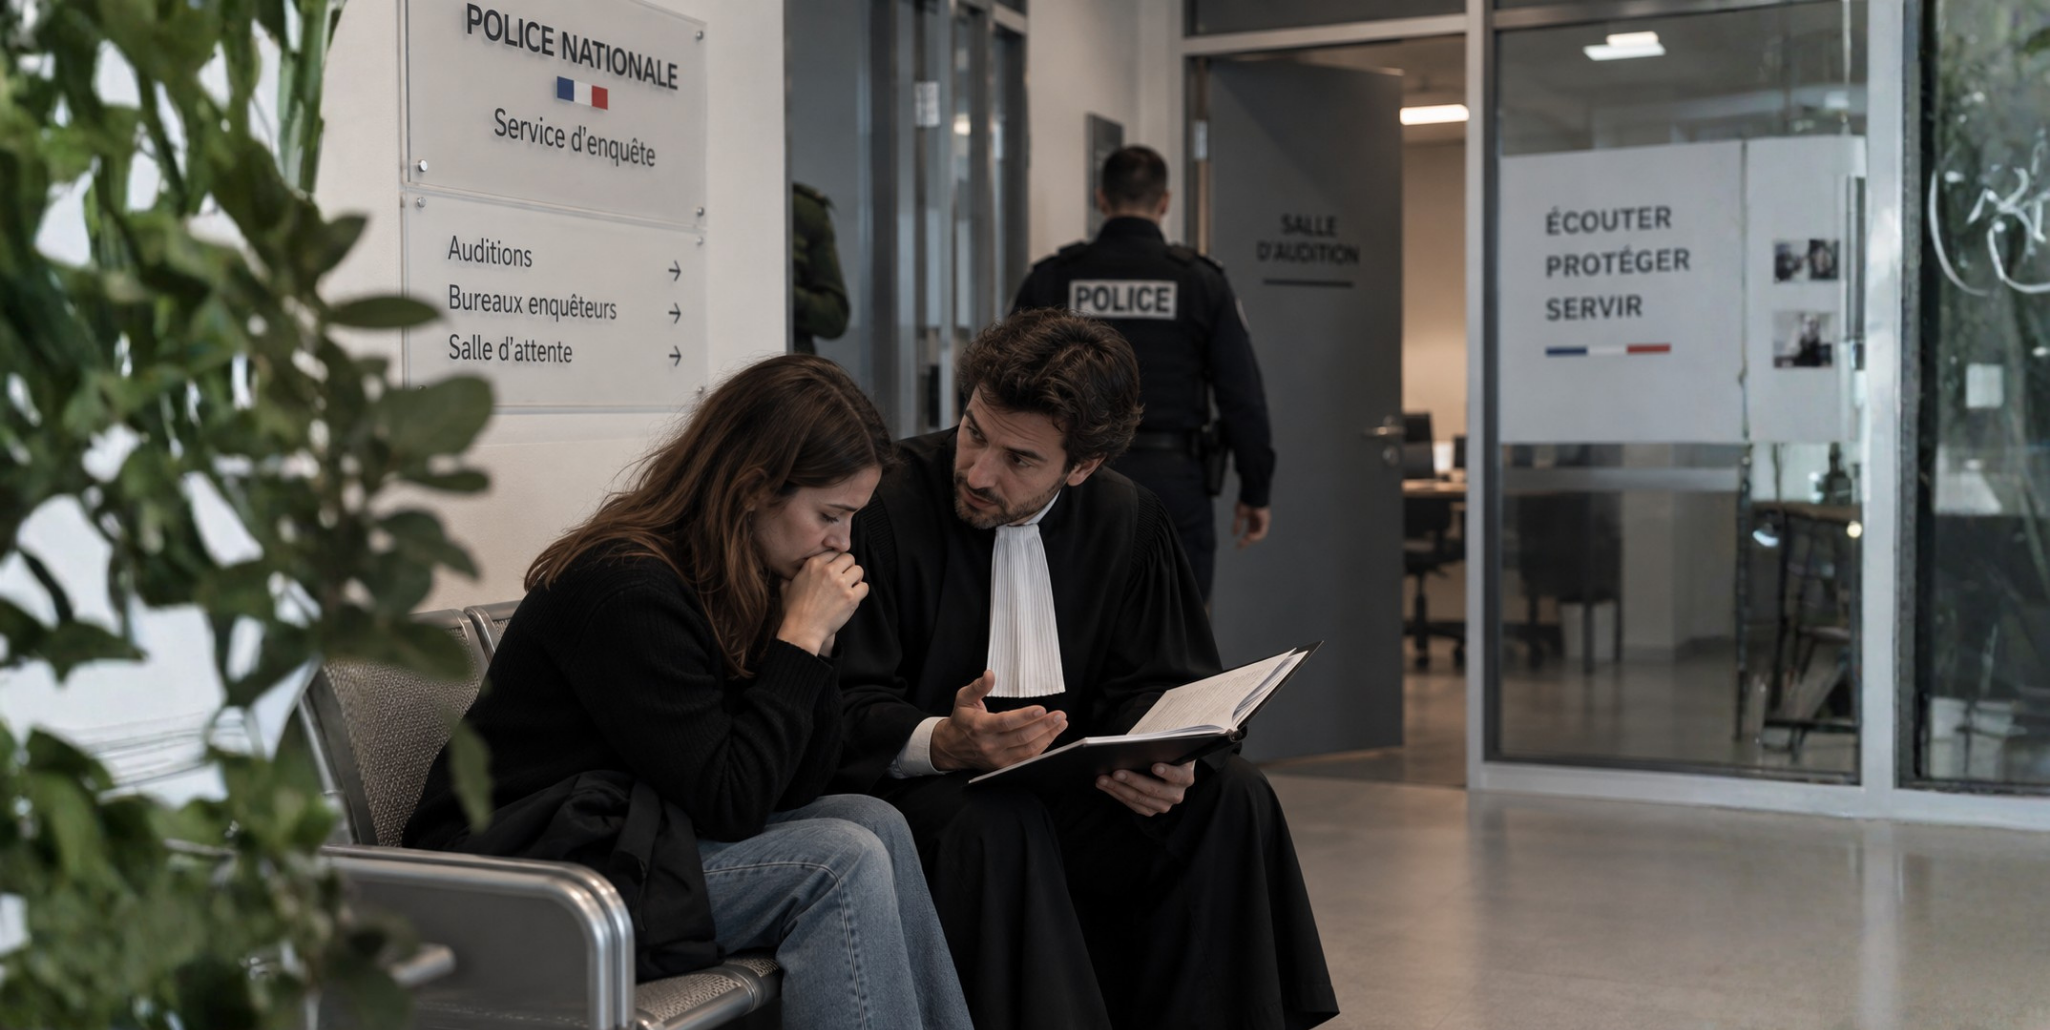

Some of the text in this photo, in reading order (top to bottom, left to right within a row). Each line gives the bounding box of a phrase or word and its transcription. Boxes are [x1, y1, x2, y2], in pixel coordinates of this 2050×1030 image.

[466, 3, 679, 91] POLICE NATIONALE
[494, 107, 656, 168] Service d’enquête
[1280, 213, 1337, 238] SALLE
[1545, 206, 1672, 236] ÉCOUTER
[447, 234, 533, 268] Auditions
[1545, 245, 1691, 278] PROTÉGER
[448, 284, 617, 322] Bureaux enquêteurs
[1075, 286, 1171, 313] POLICE
[1545, 295, 1643, 321] SERVIR
[448, 333, 573, 364] Salle d’attente
